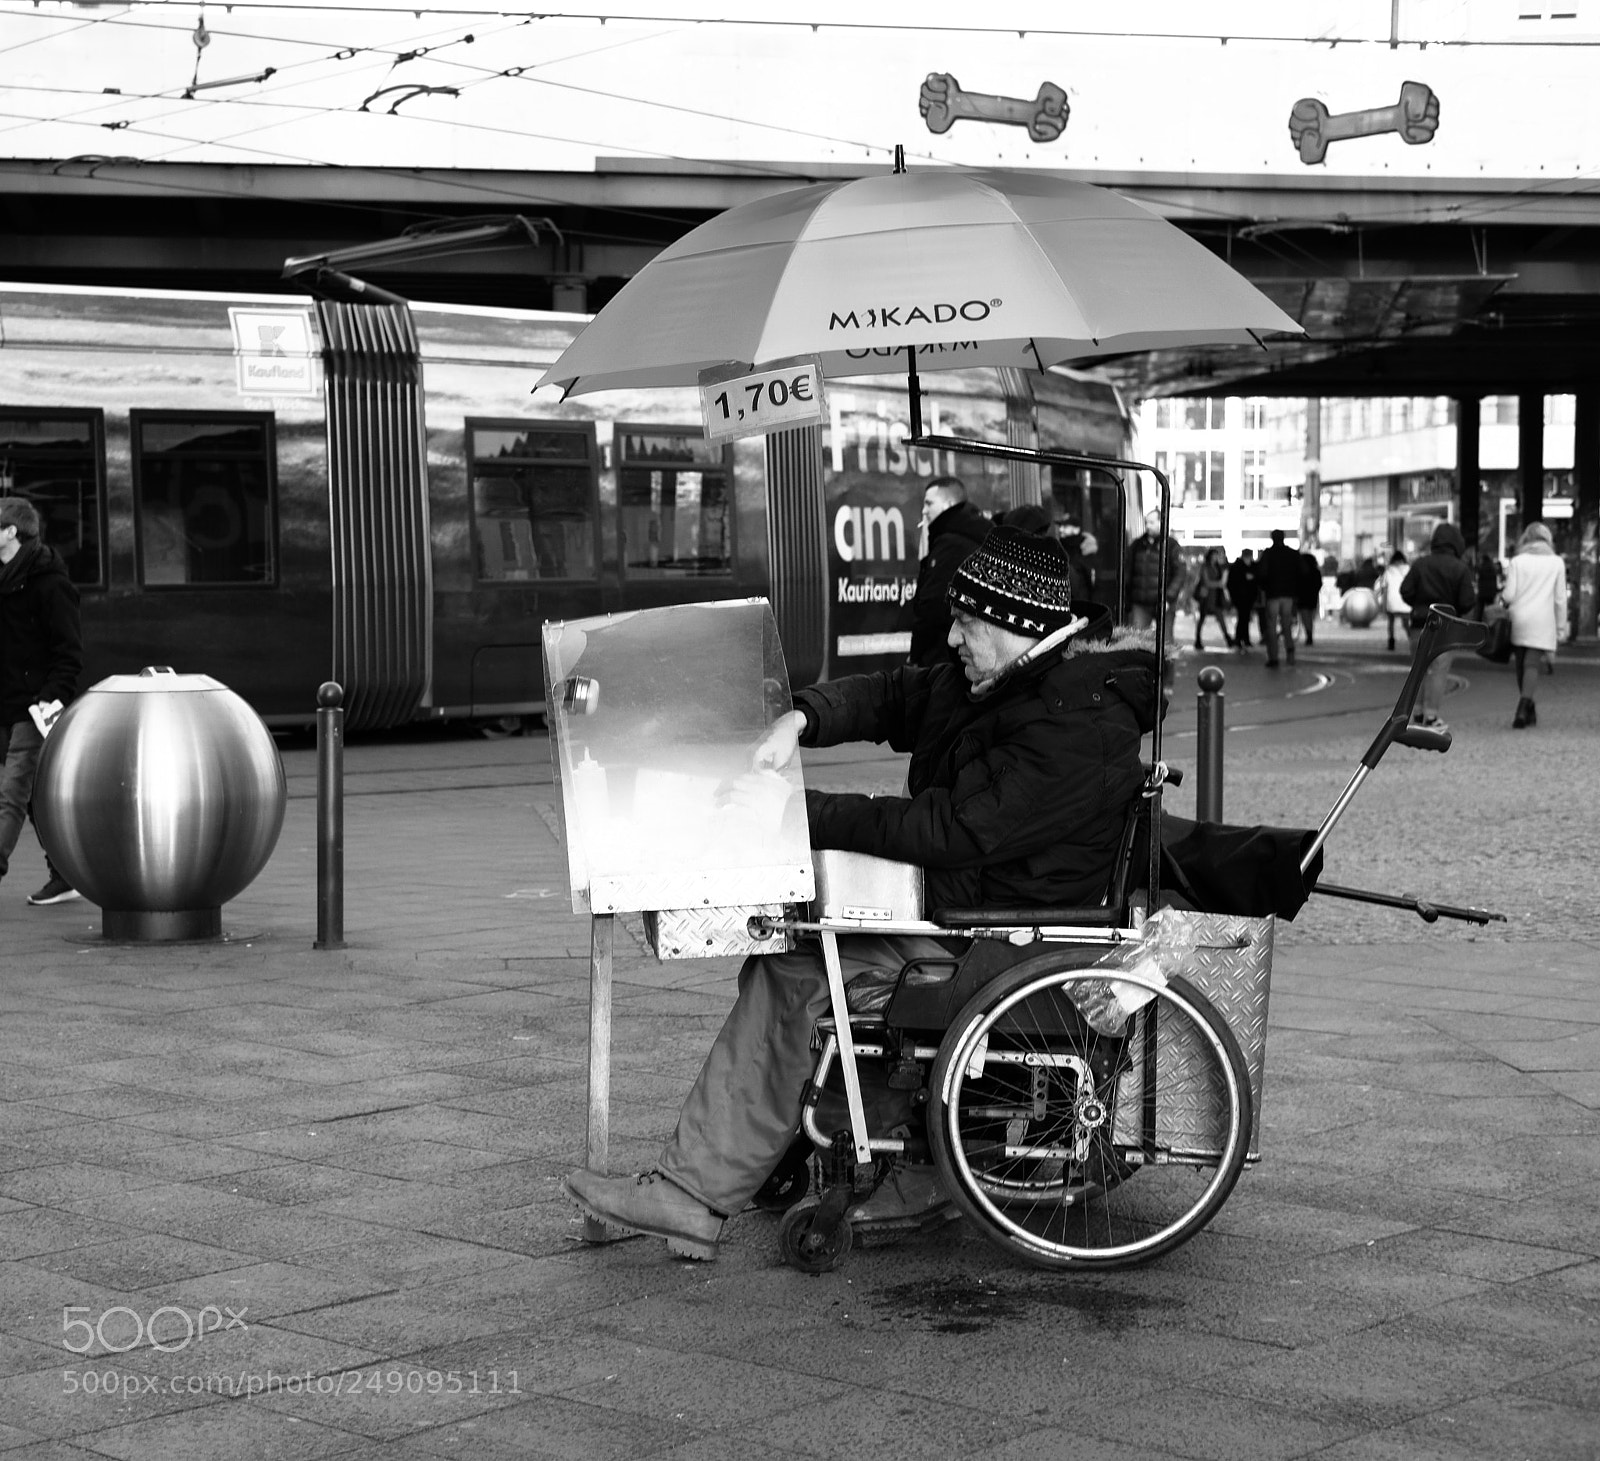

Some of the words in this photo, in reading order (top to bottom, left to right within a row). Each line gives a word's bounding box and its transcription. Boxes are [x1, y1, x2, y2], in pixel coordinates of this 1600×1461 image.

[247, 364, 305, 378] Kaufland
[714, 374, 814, 421] 1,70€
[834, 504, 906, 562] am
[838, 576, 899, 603] Kaufland
